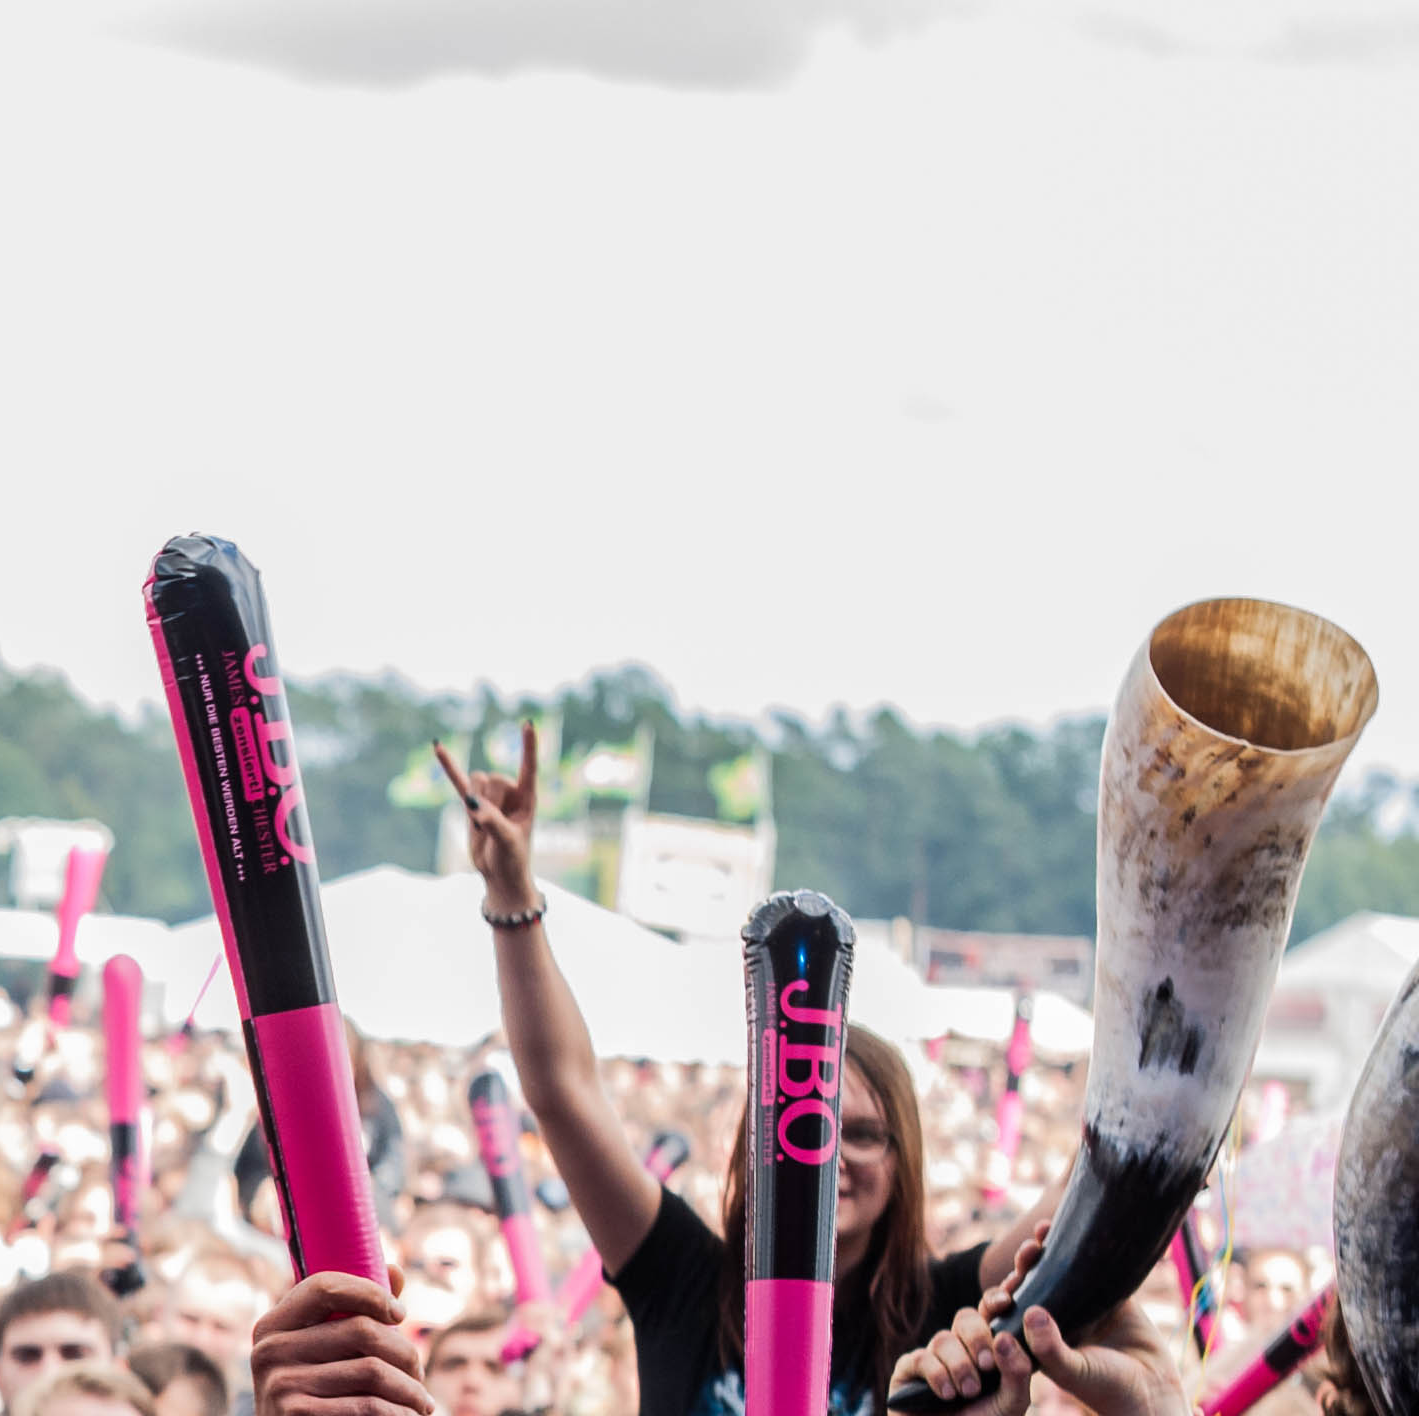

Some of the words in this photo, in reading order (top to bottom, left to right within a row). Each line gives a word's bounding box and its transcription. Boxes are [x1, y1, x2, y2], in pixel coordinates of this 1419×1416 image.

[199, 673, 213, 702] NUR
[222, 650, 246, 706] JAMES
[206, 703, 219, 728] DIE
[211, 728, 228, 777] BESTEN
[221, 780, 239, 834] WERDEN
[231, 837, 244, 860] ALT
[777, 979, 842, 1166] J.B.O.
